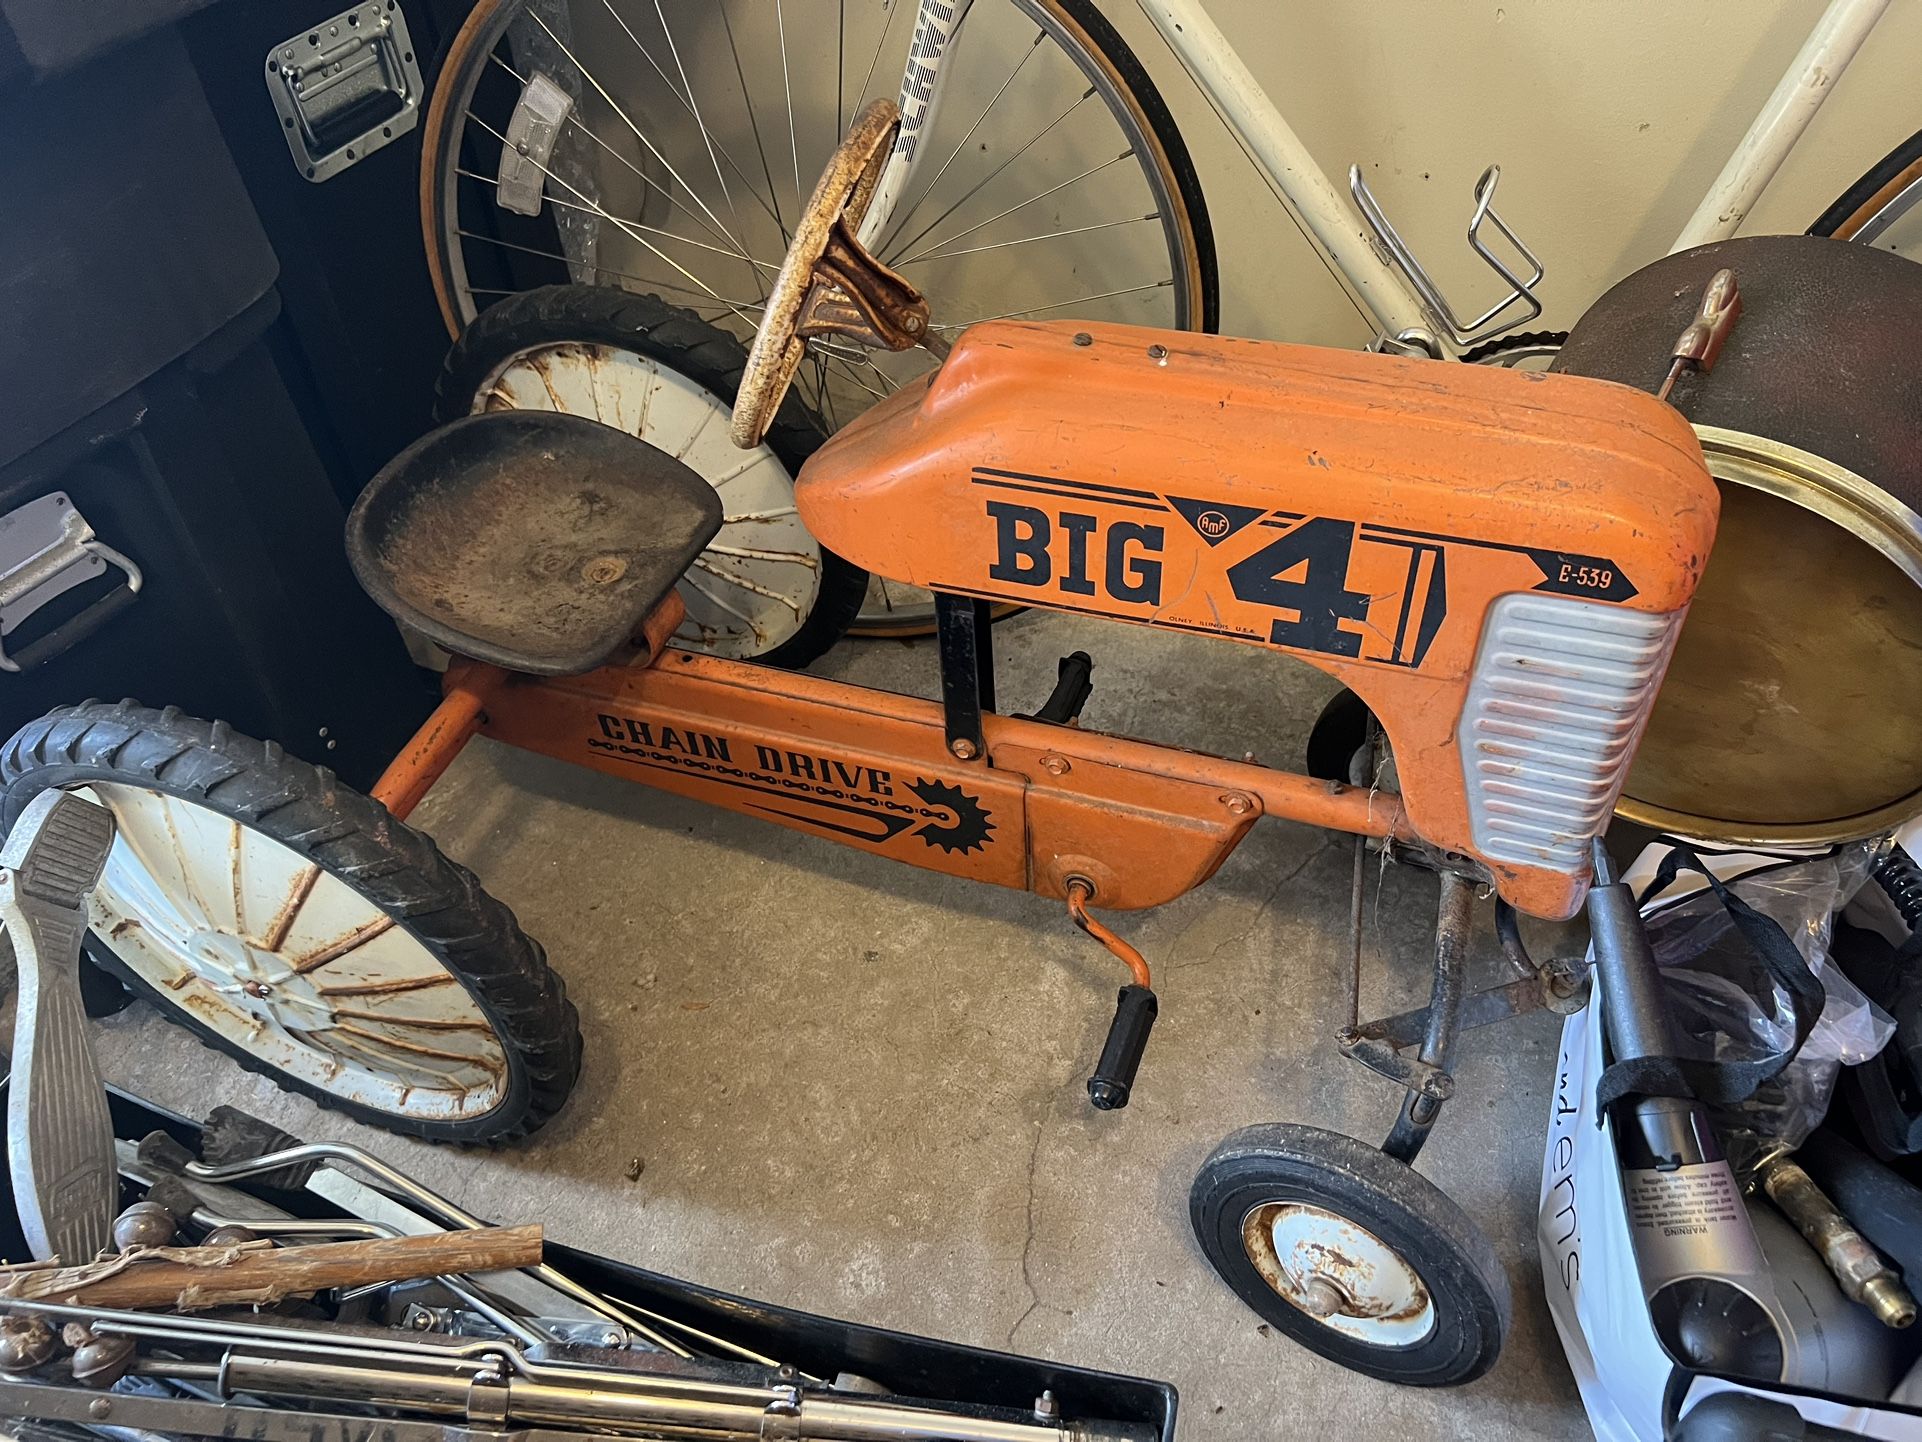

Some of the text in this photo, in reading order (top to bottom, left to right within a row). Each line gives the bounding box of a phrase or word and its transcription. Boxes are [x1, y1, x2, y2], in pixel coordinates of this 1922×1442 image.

[986, 500, 1372, 659] BIG 4
[1558, 564, 1612, 589] E-539
[596, 713, 894, 797] CHAIN DRIVE
[1663, 1226, 1708, 1237] WARNING
